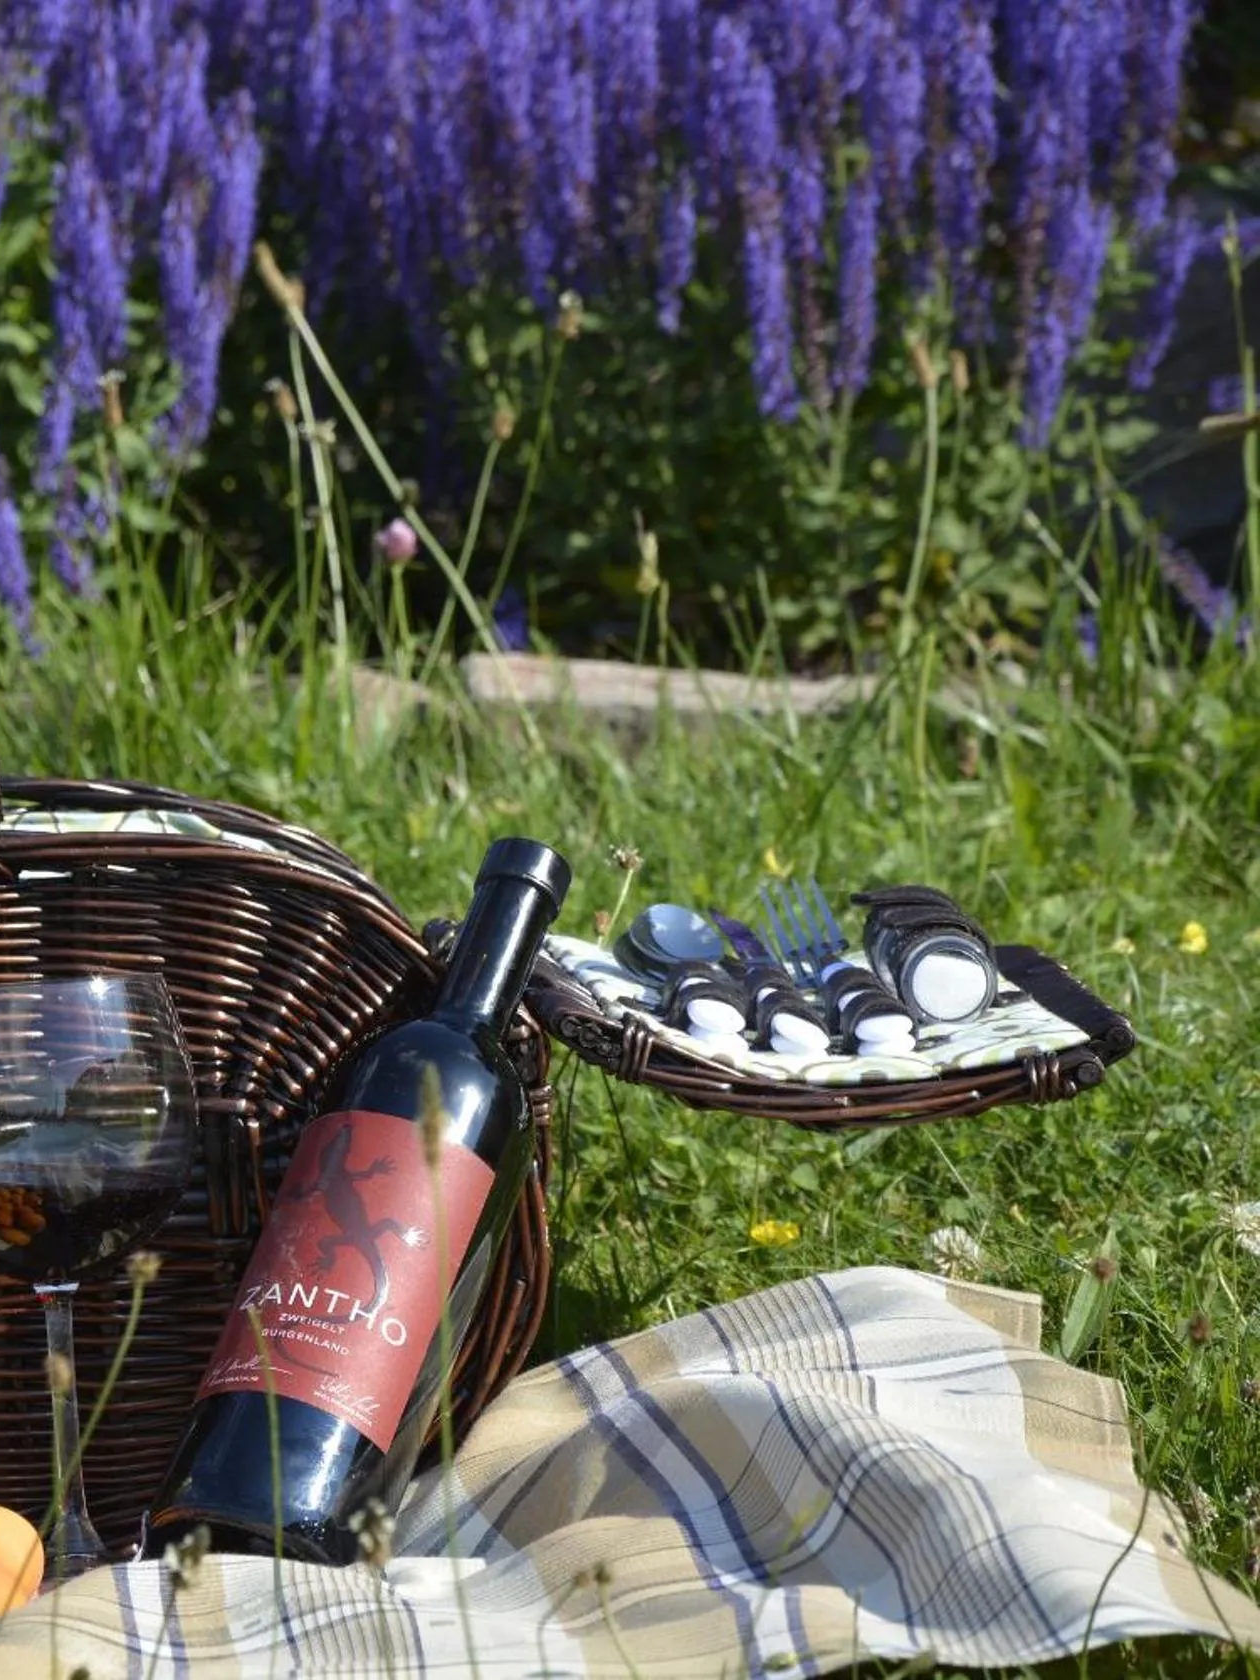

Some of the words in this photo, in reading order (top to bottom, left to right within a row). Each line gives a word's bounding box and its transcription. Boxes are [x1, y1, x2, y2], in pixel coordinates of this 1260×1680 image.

[240, 1282, 407, 1347] ZANTHO
[279, 1312, 346, 1335] ZWEIGELT
[261, 1327, 350, 1356] BURGENLAND
